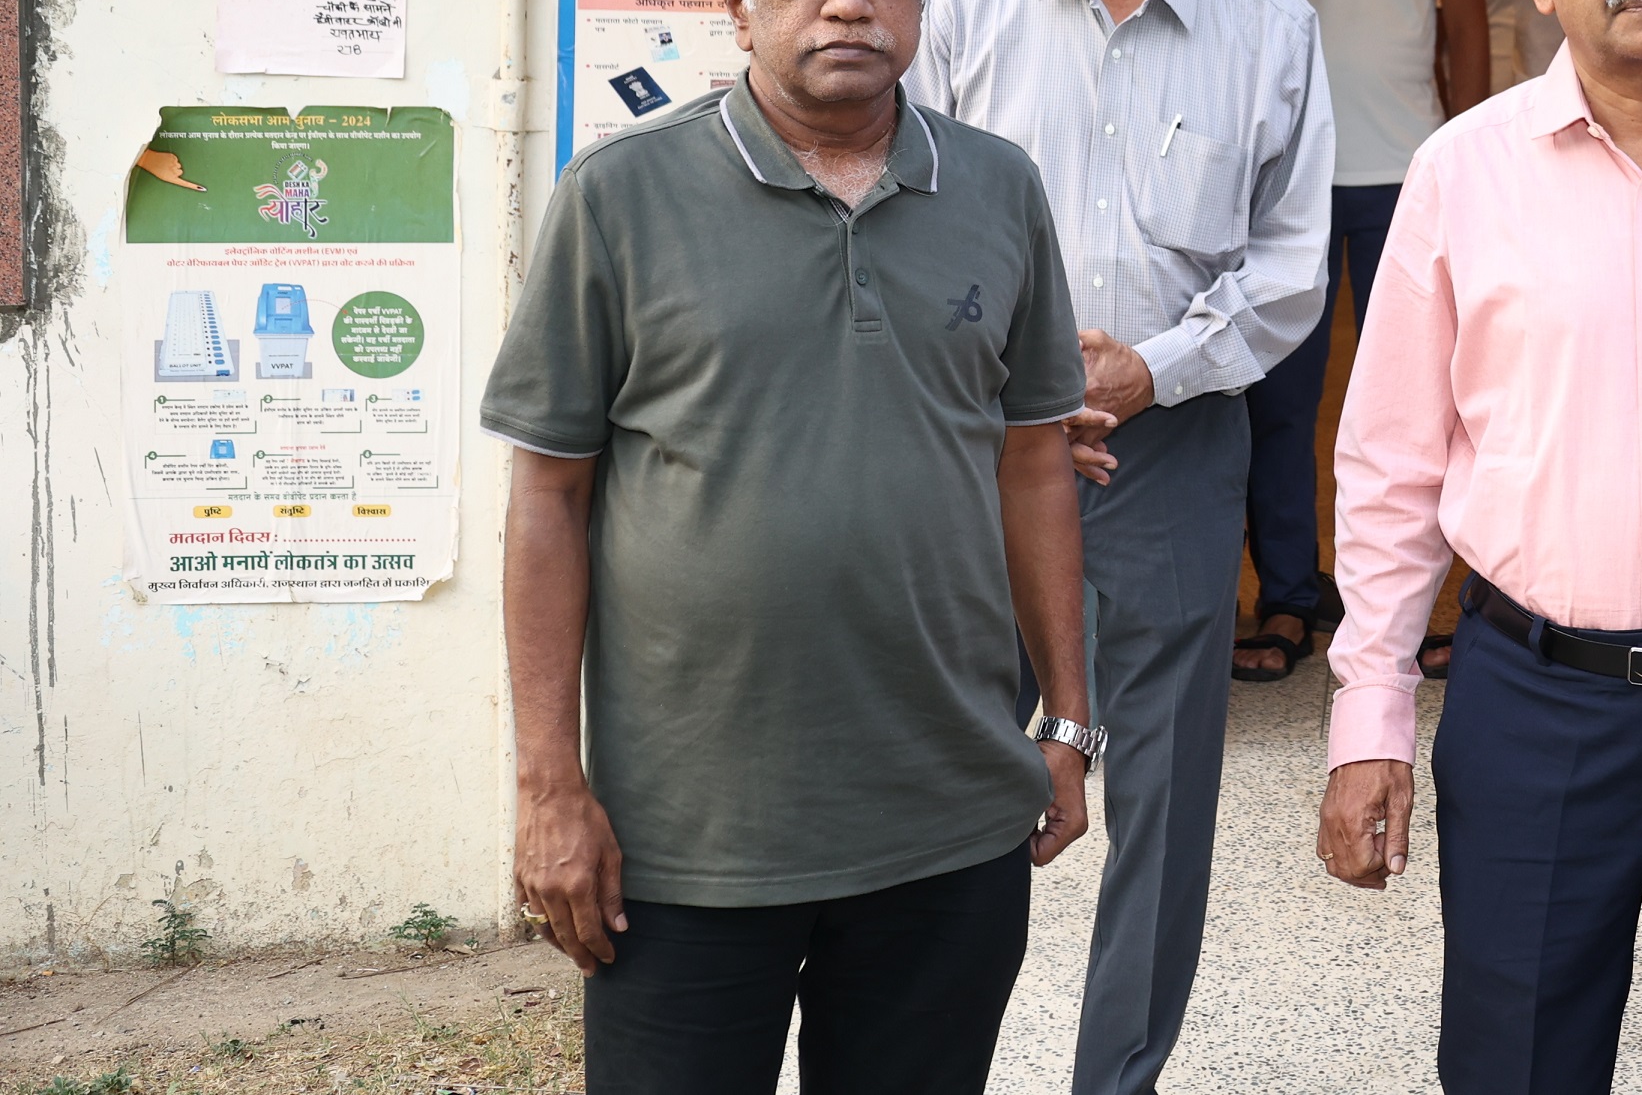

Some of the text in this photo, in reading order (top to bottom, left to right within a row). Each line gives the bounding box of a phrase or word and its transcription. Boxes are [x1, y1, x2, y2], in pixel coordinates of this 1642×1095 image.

[679, 0, 713, 9] पहचान
[211, 112, 263, 126] लोकसभा
[266, 115, 291, 126] आम
[341, 115, 371, 126] 2024
[285, 189, 310, 197] MAHA
[321, 247, 346, 255] (EVM)
[289, 259, 320, 267] (VVPAT)
[204, 507, 222, 516] पुष्टि
[357, 506, 387, 515] विश्वास
[169, 527, 271, 544] मतदान दिवस
[170, 550, 416, 572] आओ मनायें लोकतंत्र का उत्सव
[148, 580, 176, 593] मुख्य
[179, 578, 219, 590] निर्वाचन
[320, 579, 341, 588] द्वारा
[344, 577, 380, 588] जनहित
[383, 576, 392, 588] में
